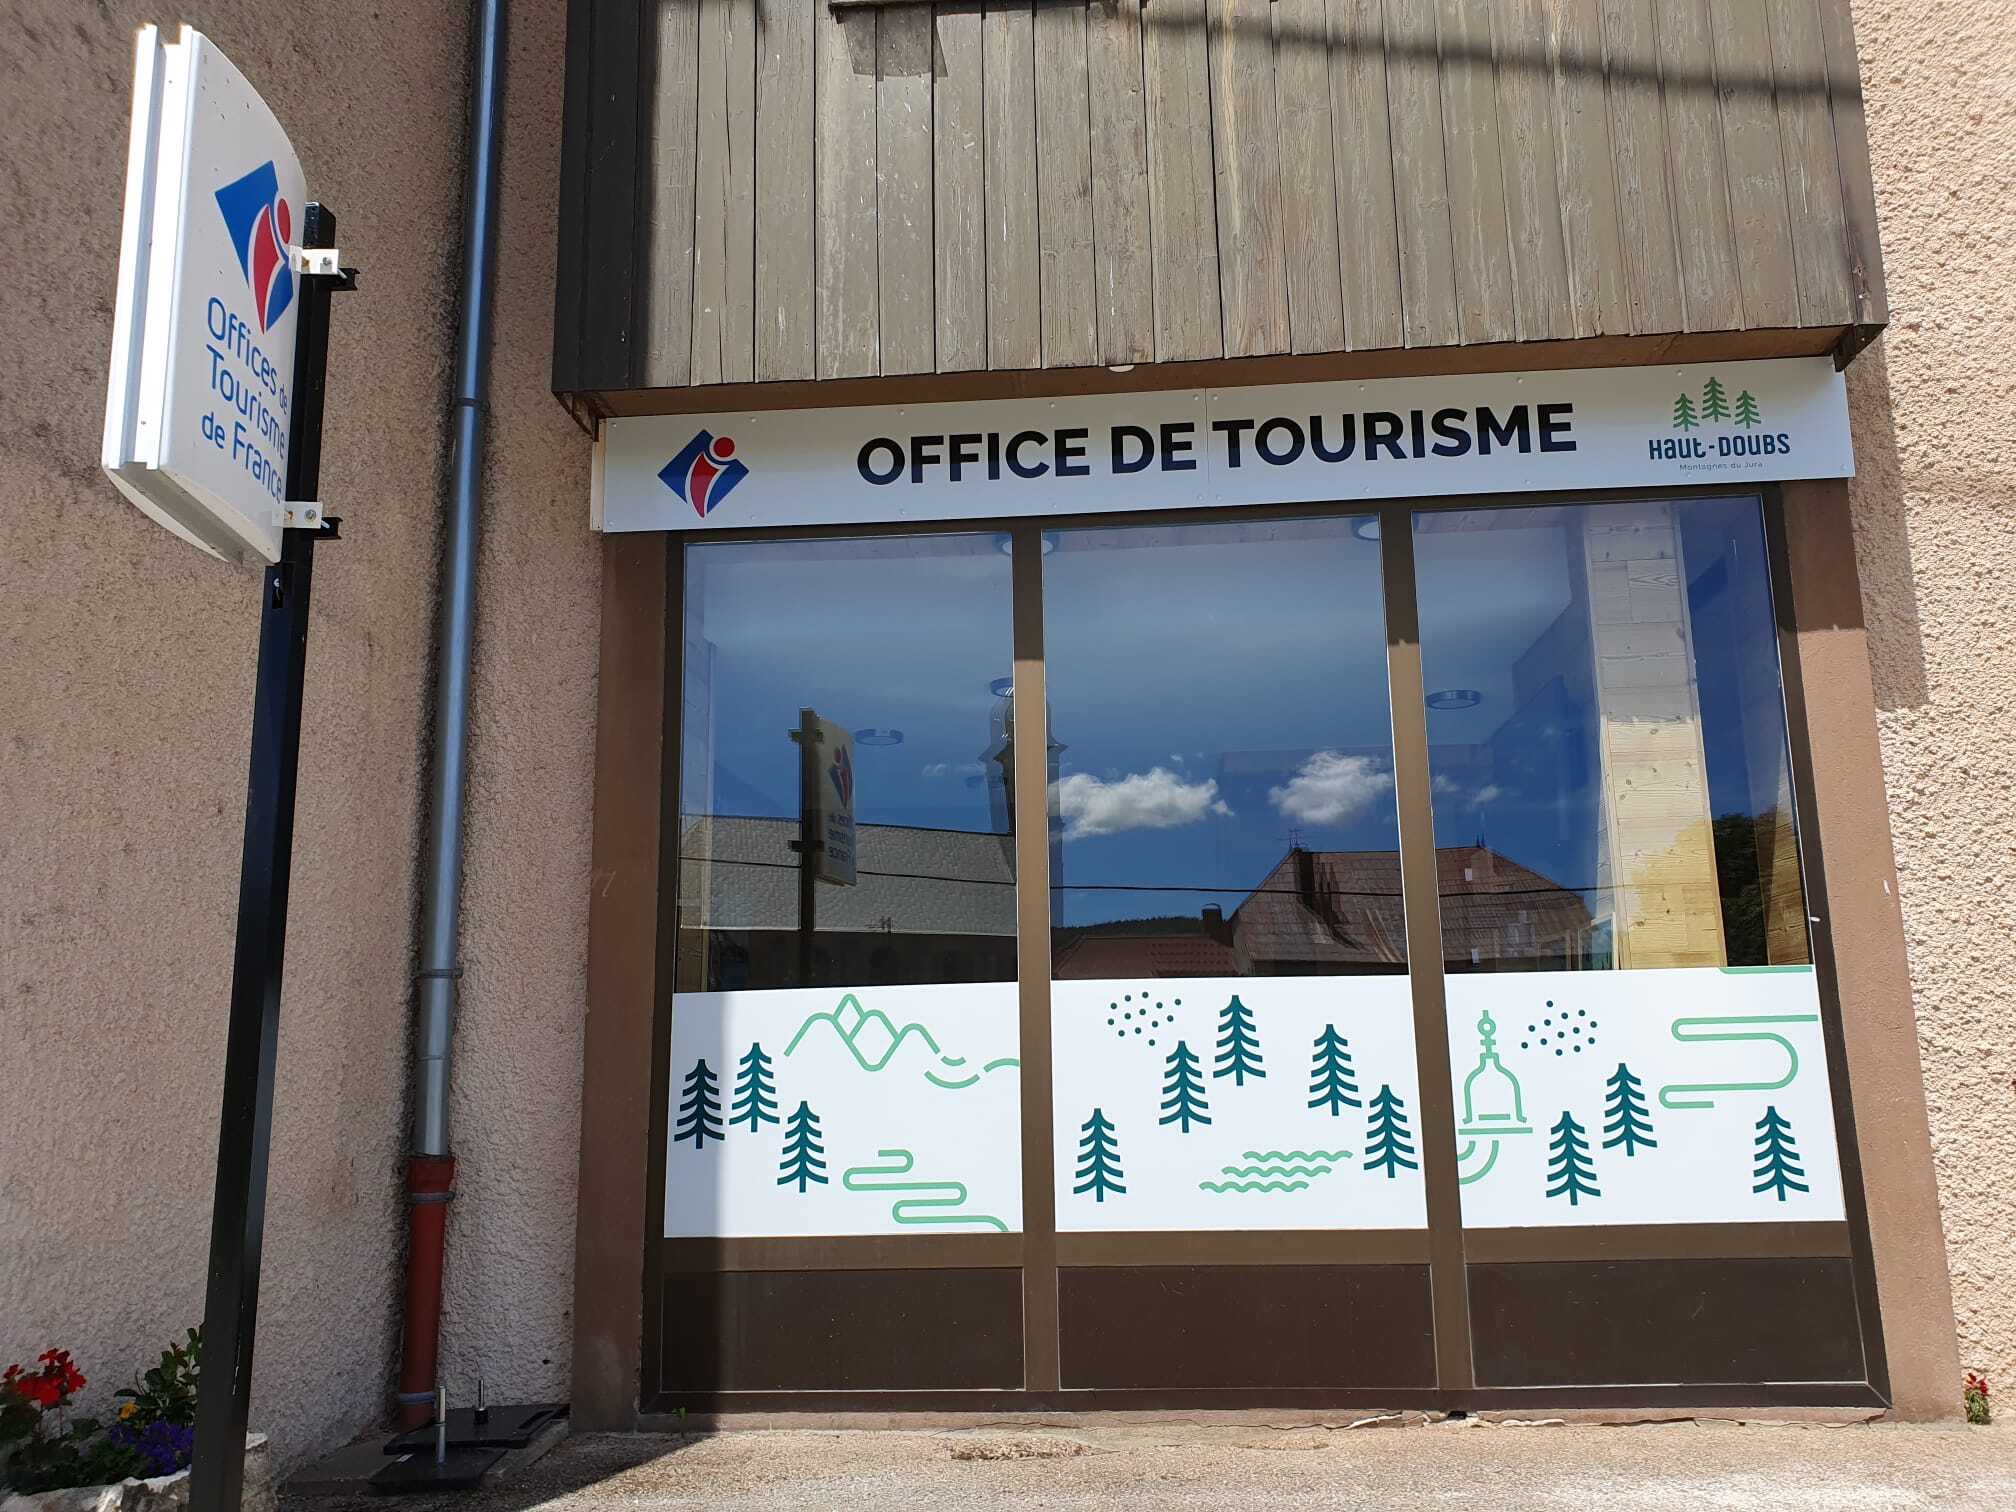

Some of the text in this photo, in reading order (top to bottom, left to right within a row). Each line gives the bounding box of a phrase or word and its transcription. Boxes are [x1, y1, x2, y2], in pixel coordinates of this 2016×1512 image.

[207, 344, 284, 460] Tourisme
[208, 297, 288, 415] Offices de
[202, 412, 282, 504] de France
[857, 403, 1577, 485] OFFICE DE TOURISME
[1680, 463, 1728, 472] Montagnes
[1745, 461, 1763, 469] Jura
